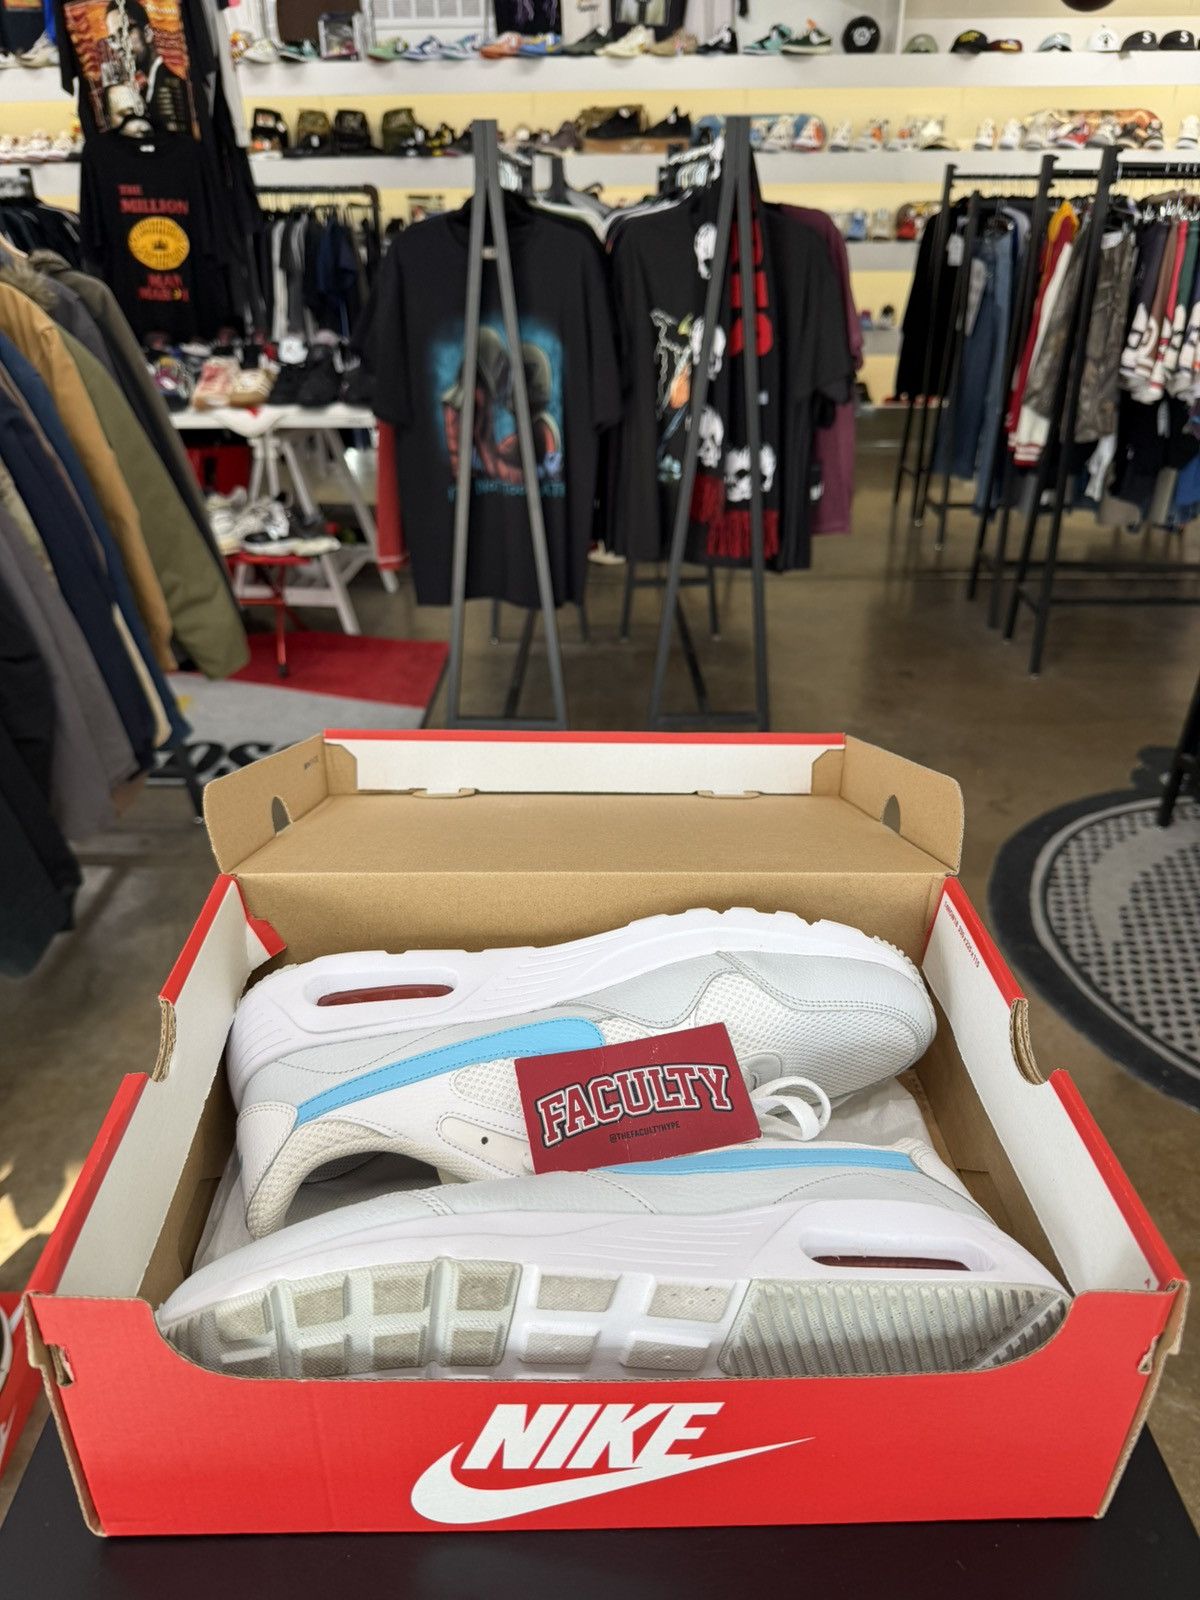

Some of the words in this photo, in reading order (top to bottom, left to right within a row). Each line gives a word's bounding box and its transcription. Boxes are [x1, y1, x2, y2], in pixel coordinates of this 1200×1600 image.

[118, 184, 142, 196] THE
[120, 199, 189, 215] MILLION
[536, 1063, 733, 1148] FACULTY
[609, 1120, 681, 1144] @THEFACULTYHYPE
[461, 1402, 726, 1469] NIKE
